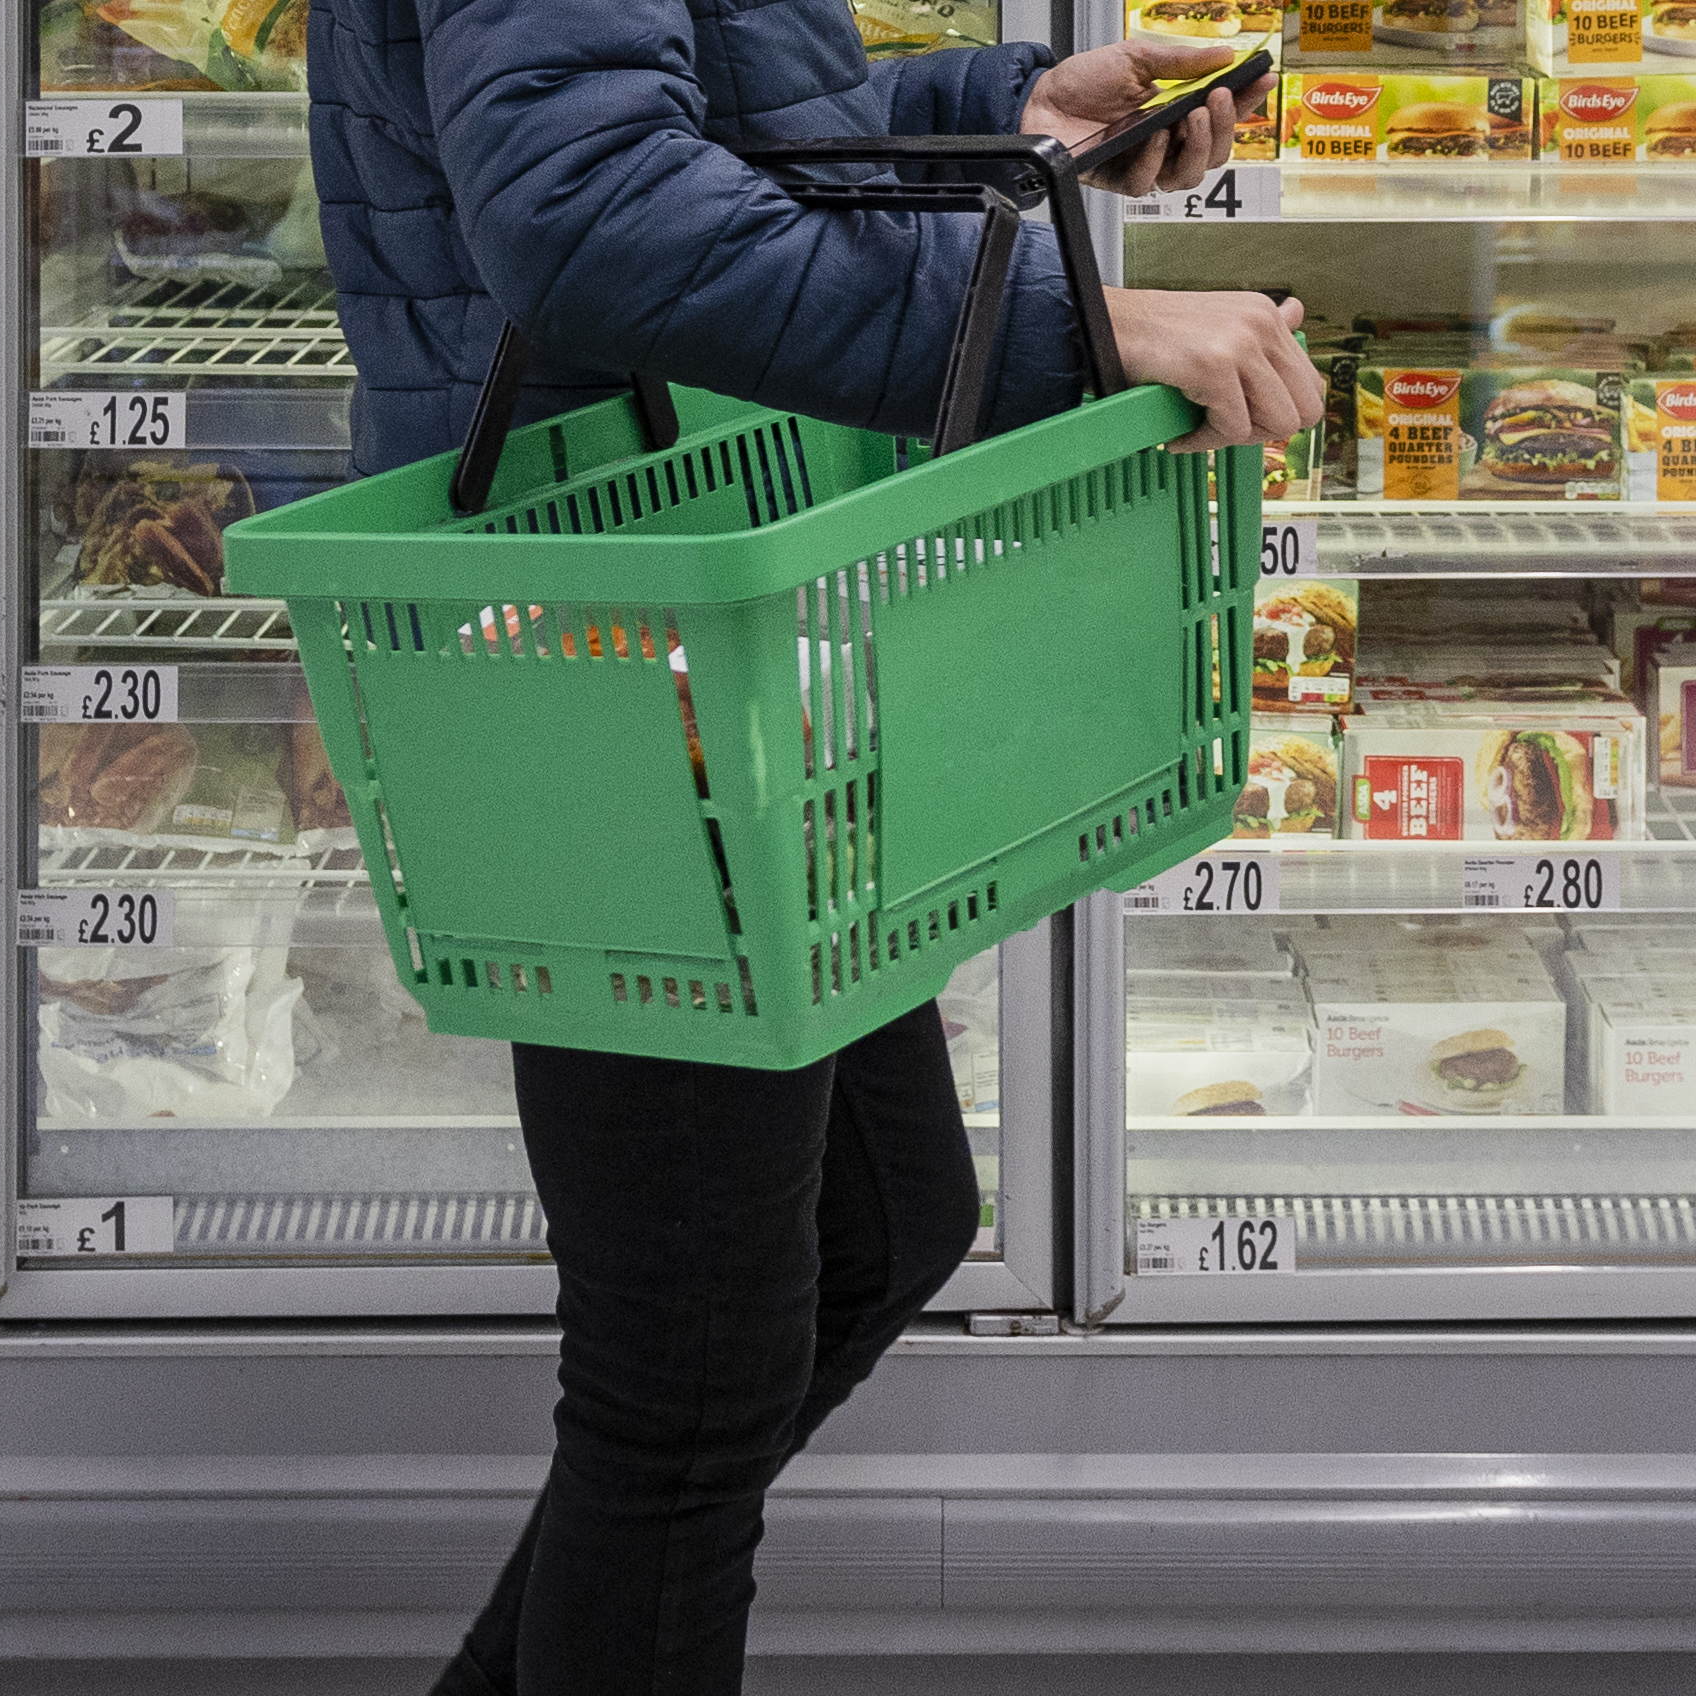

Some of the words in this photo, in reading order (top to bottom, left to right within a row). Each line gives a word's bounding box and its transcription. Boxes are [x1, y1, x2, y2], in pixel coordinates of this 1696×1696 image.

[1306, 5, 1327, 20] 10
[1332, 5, 1369, 20] BEEF
[1574, 15, 1593, 30] 10
[1596, 14, 1638, 30] BEEF
[1309, 91, 1368, 106] BirdsEye
[1568, 93, 1625, 107] BirdsEye
[86, 103, 142, 153] £2
[1305, 124, 1371, 137] ORIGINAL
[1307, 140, 1327, 156] 10
[1331, 140, 1373, 155] BEEF
[1566, 143, 1585, 157] 10
[1589, 142, 1632, 157] BEEF
[1185, 170, 1242, 217] £4
[1392, 380, 1449, 397] BirdsEye
[90, 395, 170, 446] £1.25
[1388, 413, 1453, 426] ORIGINAL
[1405, 426, 1454, 441] BEEF
[1388, 442, 1453, 454] QUARTER
[1388, 454, 1453, 465] POUNDERS
[82, 669, 161, 719] £2.30
[1373, 790, 1397, 811] 4
[1409, 764, 1428, 837] BEEF
[1184, 861, 1262, 911] £2.70
[1524, 859, 1602, 909] £2.80
[79, 894, 158, 944] £2.30
[1326, 1027, 1344, 1041] 10
[1348, 1026, 1382, 1041] Beef
[1326, 1043, 1384, 1061] Burgers
[1625, 1051, 1643, 1065] 10
[1647, 1051, 1682, 1066] Beef
[1625, 1068, 1685, 1084] Burgers
[77, 1201, 126, 1252] £1
[1199, 1220, 1279, 1271] £1.62
